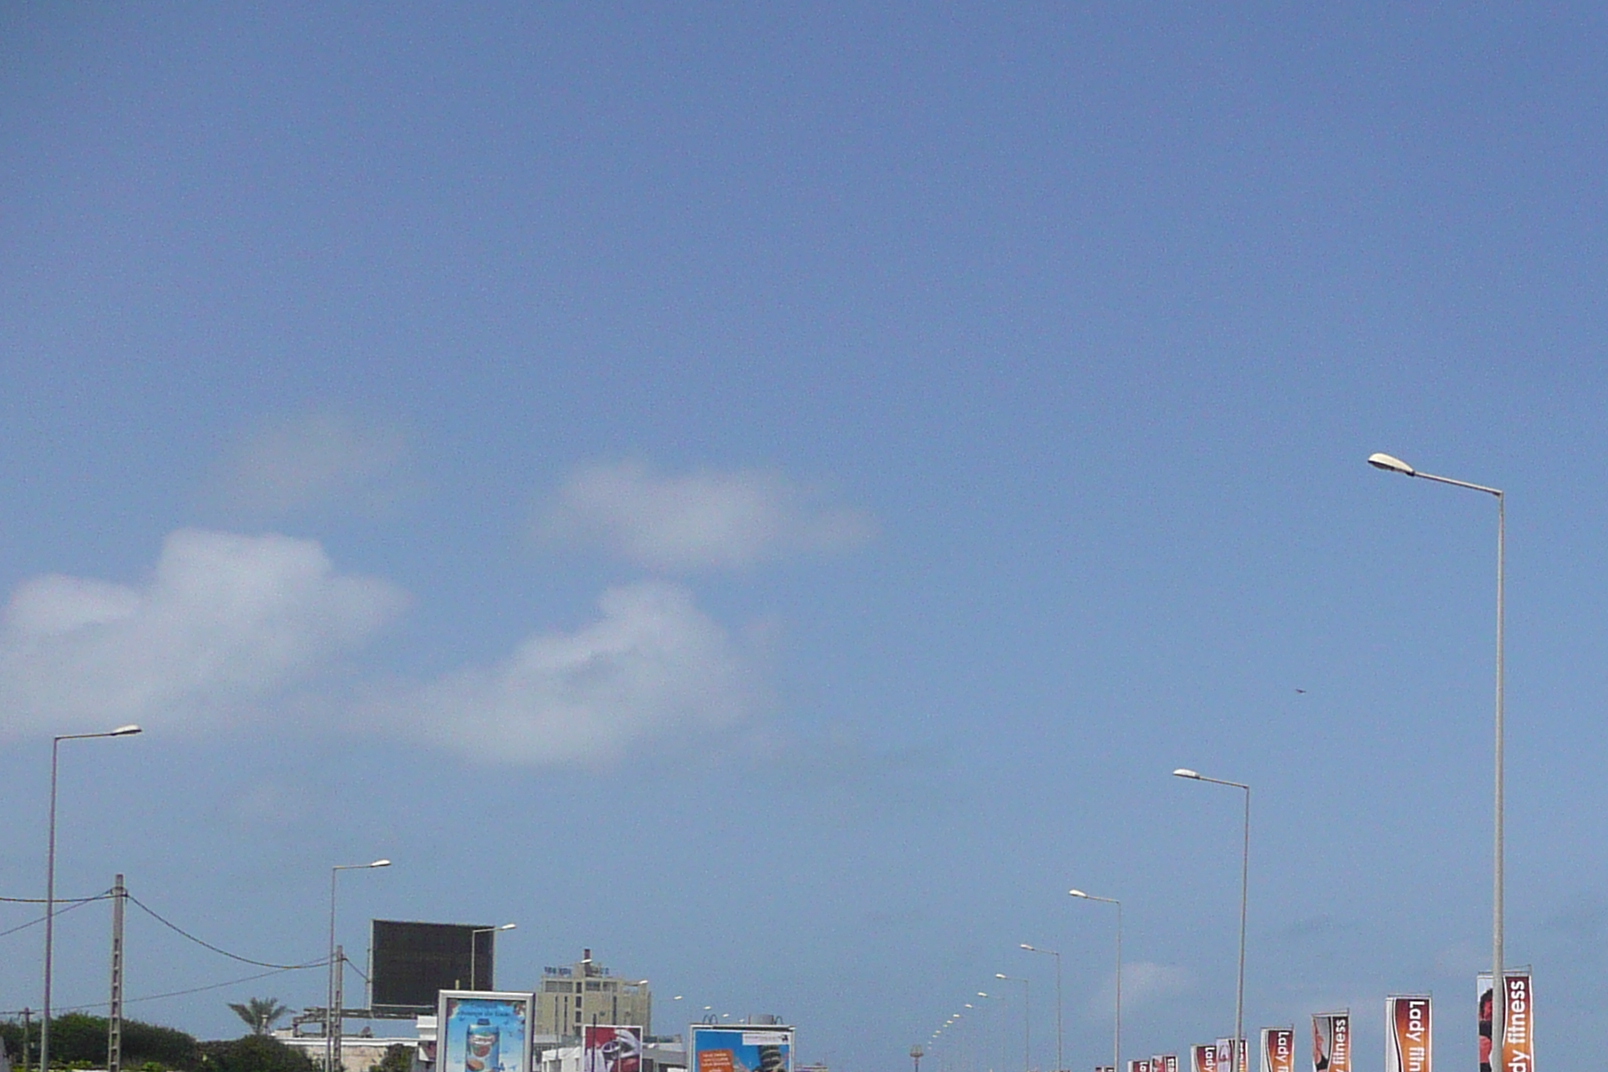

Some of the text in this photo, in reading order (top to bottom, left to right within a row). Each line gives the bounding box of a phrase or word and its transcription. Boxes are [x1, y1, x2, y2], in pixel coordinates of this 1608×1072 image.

[1405, 1001, 1426, 1042] Lady
[1507, 980, 1526, 1045] fitness
[1204, 1047, 1216, 1072] Lady
[1275, 1031, 1290, 1062] Lady
[1333, 1019, 1346, 1064] fitness
